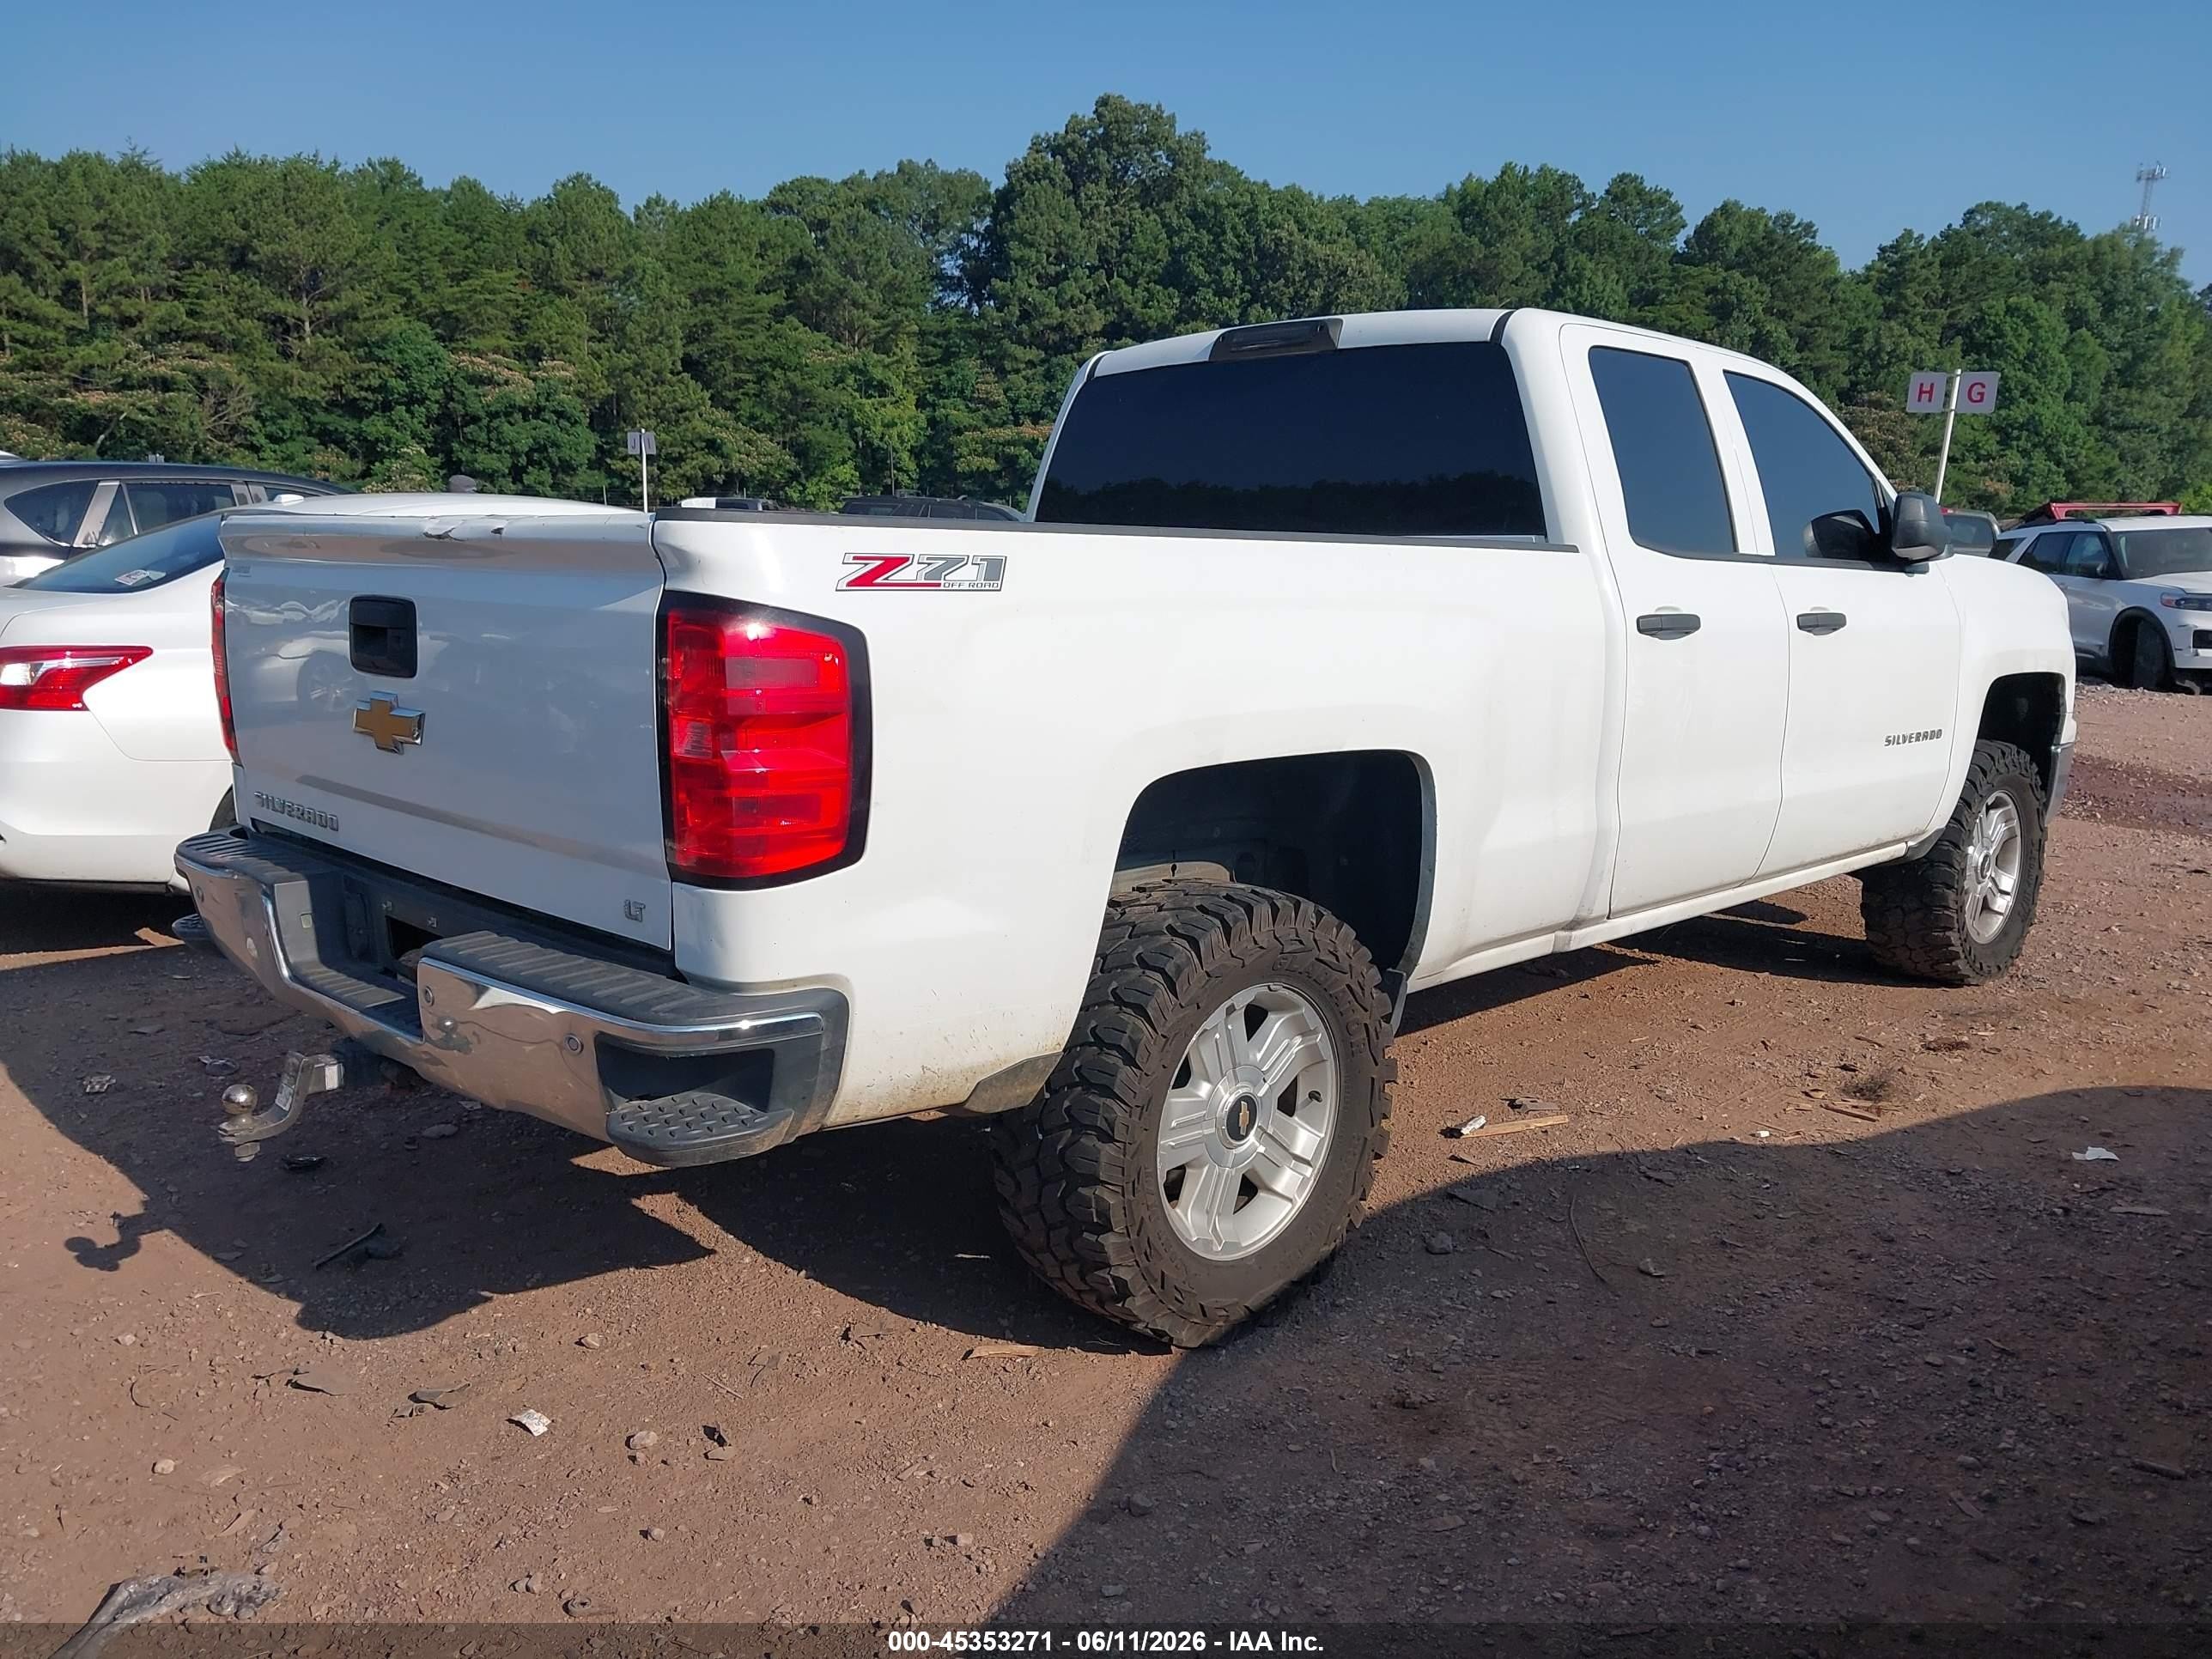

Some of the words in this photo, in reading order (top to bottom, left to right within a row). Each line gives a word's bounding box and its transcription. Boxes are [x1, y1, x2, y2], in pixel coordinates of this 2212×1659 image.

[1917, 382, 1935, 403] H
[1967, 382, 1986, 403] G
[836, 552, 1007, 591] Z71
[1884, 729, 1942, 746] SILVERADO
[254, 791, 339, 831] SILVERADO
[624, 899, 646, 922] LT
